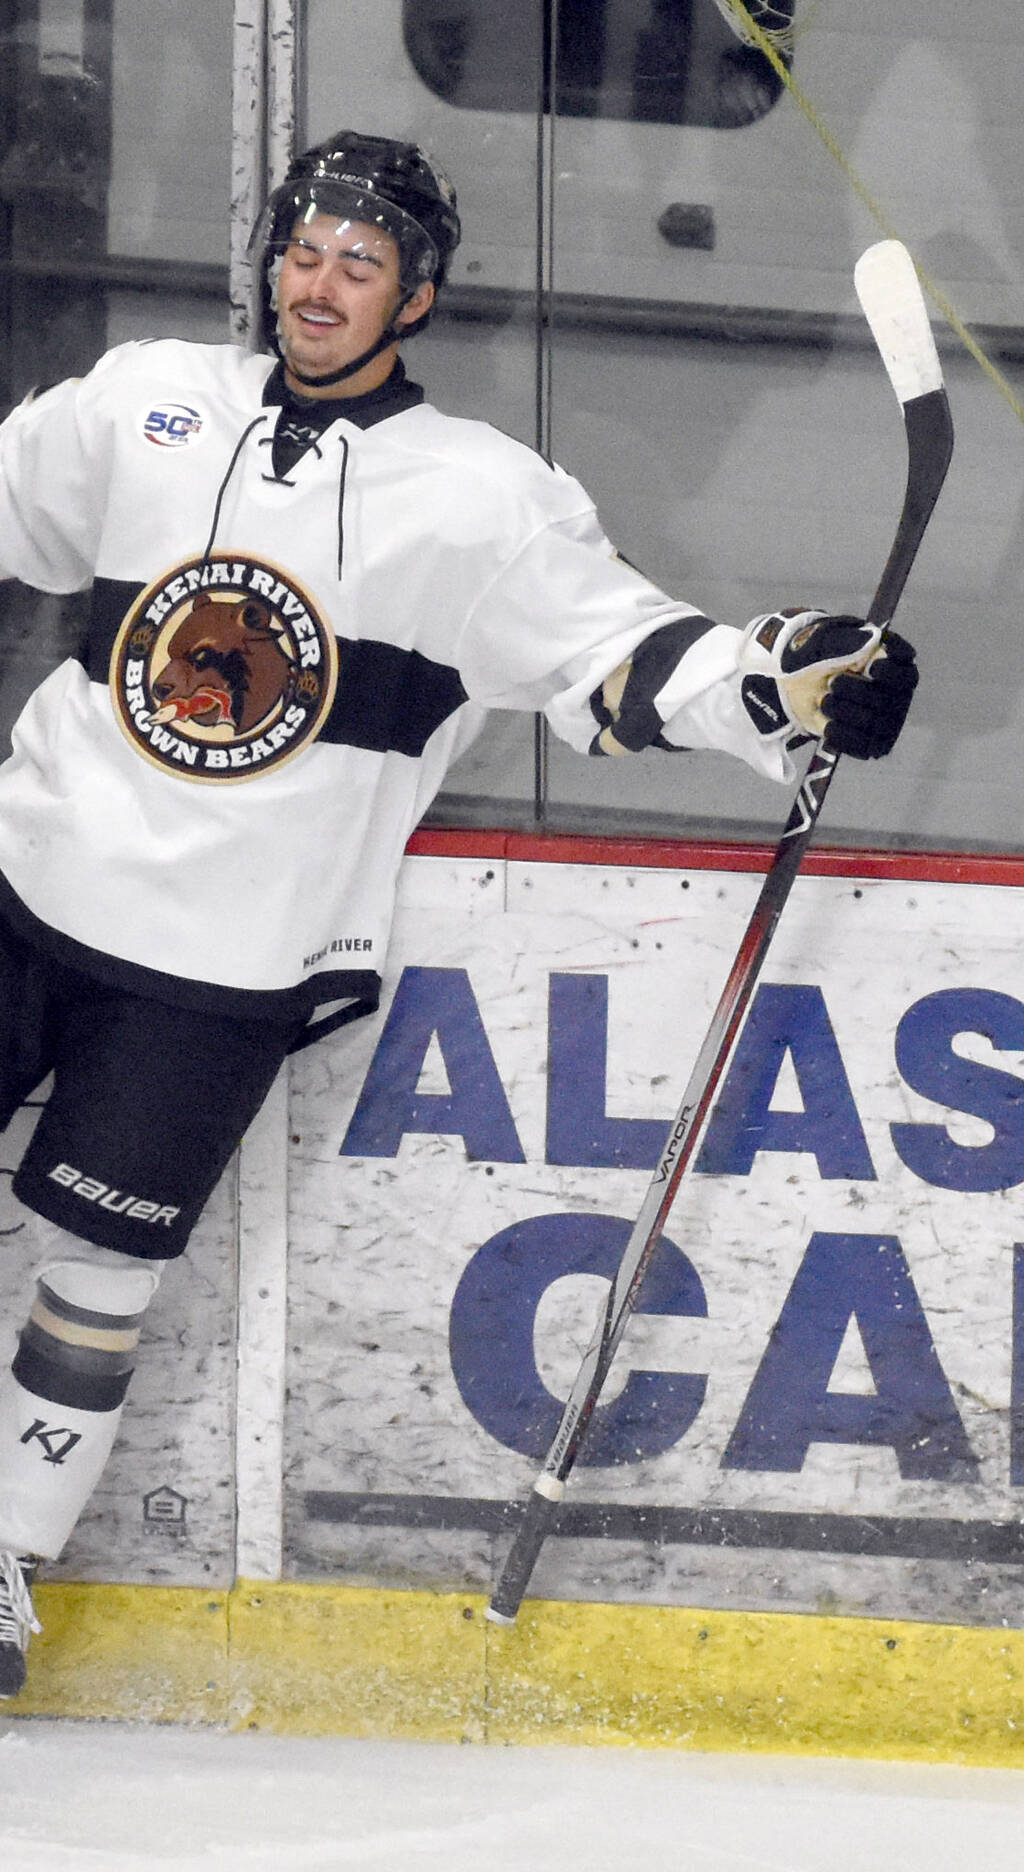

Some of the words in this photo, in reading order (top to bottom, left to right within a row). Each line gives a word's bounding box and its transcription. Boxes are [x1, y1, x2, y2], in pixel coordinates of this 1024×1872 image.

[145, 562, 246, 625] KENAI
[247, 568, 321, 668] RIVER
[125, 658, 200, 766] BROWN
[204, 704, 307, 768] BEARS
[331, 938, 373, 953] RIVER
[652, 1102, 698, 1186] VAPOR
[449, 1211, 1024, 1490] CA
